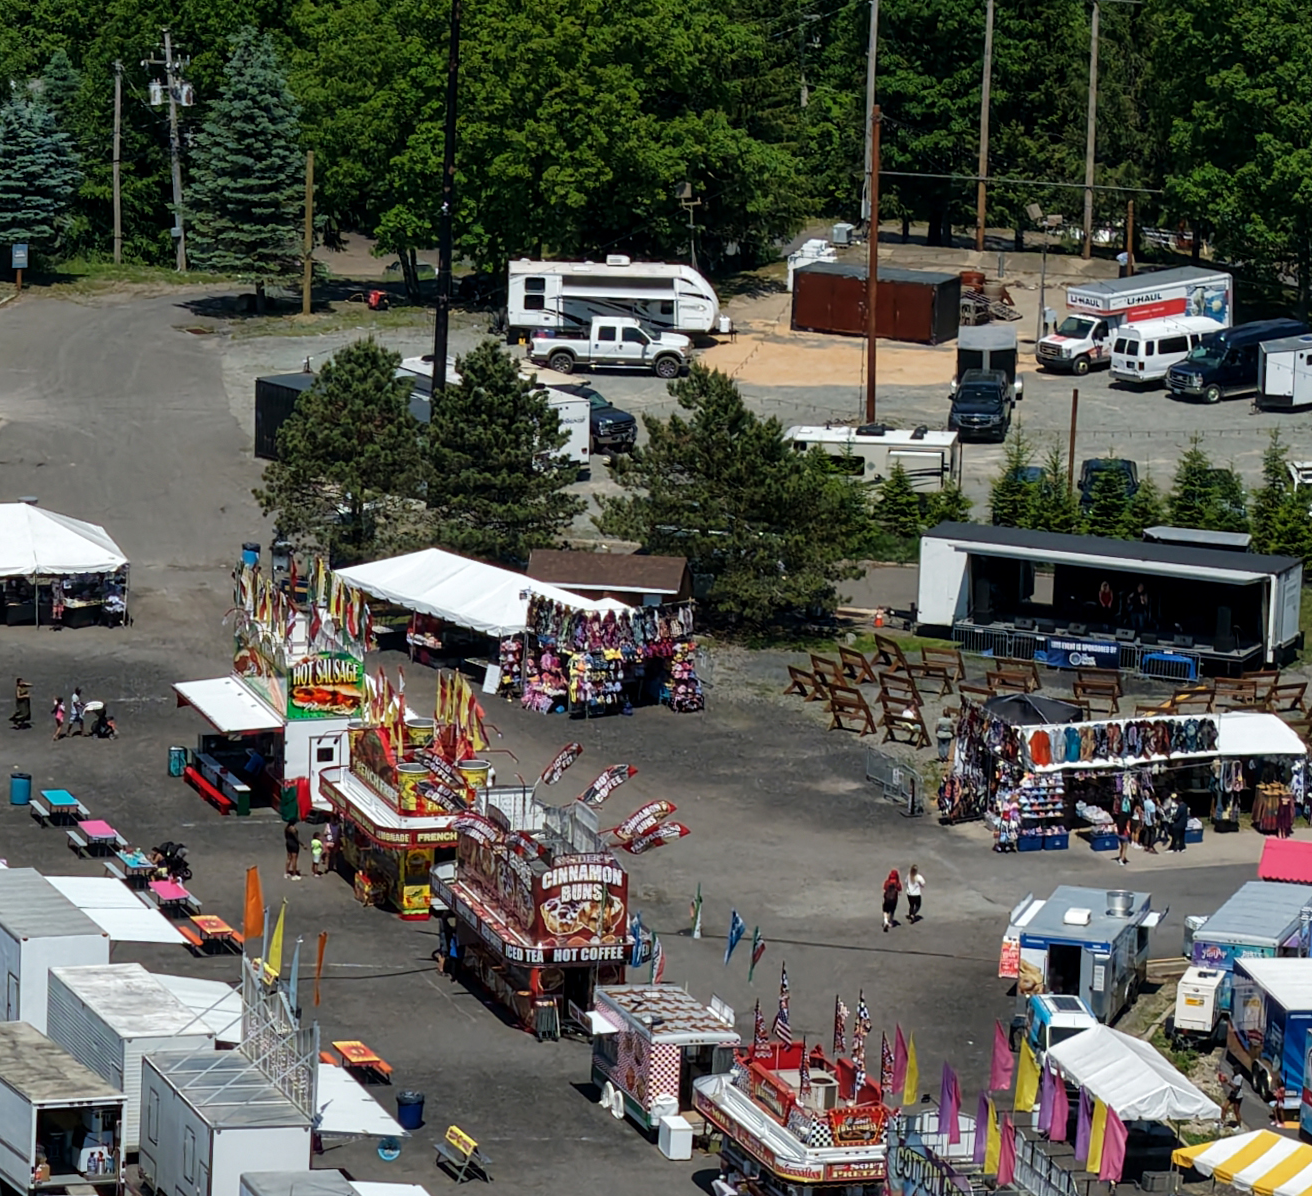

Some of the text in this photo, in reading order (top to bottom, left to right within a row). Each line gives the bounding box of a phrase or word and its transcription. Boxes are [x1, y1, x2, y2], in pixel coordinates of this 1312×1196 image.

[1070, 295, 1100, 308] U-HAUL
[1127, 293, 1162, 306] U-HAUL
[293, 661, 314, 685] HOT
[594, 771, 611, 790] HOT
[417, 832, 458, 842] FRENCH
[541, 864, 623, 890] CINNAMON
[561, 883, 603, 903] BUNS
[505, 944, 544, 963] ICED TEA
[553, 946, 624, 963] HOT COFFEE
[831, 1169, 885, 1178] PRETZE
[896, 1146, 942, 1194] COTTON
